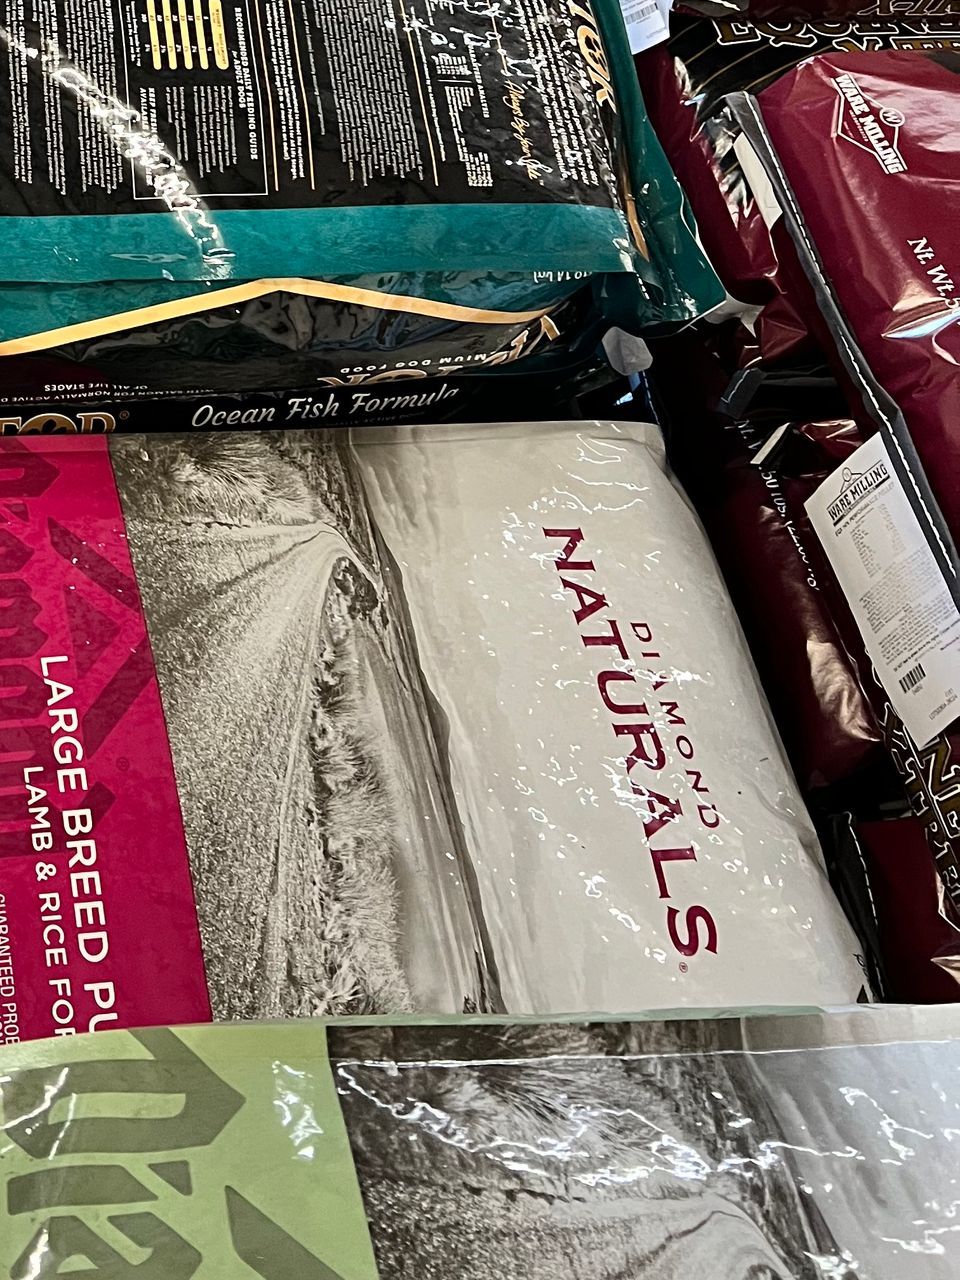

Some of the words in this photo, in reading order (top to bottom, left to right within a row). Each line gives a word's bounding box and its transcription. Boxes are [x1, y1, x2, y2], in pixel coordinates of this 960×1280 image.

[234, 7, 248, 67] RECOMMENDED
[232, 58, 243, 85] ADULT
[236, 85, 246, 109] DOGS
[241, 68, 252, 91] DAILY
[244, 91, 256, 130] FEEDING
[836, 74, 866, 118] WARE
[857, 115, 905, 176] MILLING
[247, 130, 259, 160] GUIDE
[907, 236, 931, 264] Nt.
[926, 262, 958, 303] Wt.
[44, 382, 84, 392] STAGES
[191, 404, 276, 428] Ocean
[287, 393, 341, 422] Fish
[348, 384, 460, 414] Formula
[827, 493, 851, 521] WARE
[849, 463, 889, 501] MILLING
[40, 654, 88, 793] LARGE
[542, 525, 720, 959] NATURALS
[632, 621, 721, 830] DIAMOND
[24, 765, 54, 852] LAMB
[34, 861, 58, 882] &
[62, 807, 110, 964] BREED
[39, 892, 68, 967] RICE
